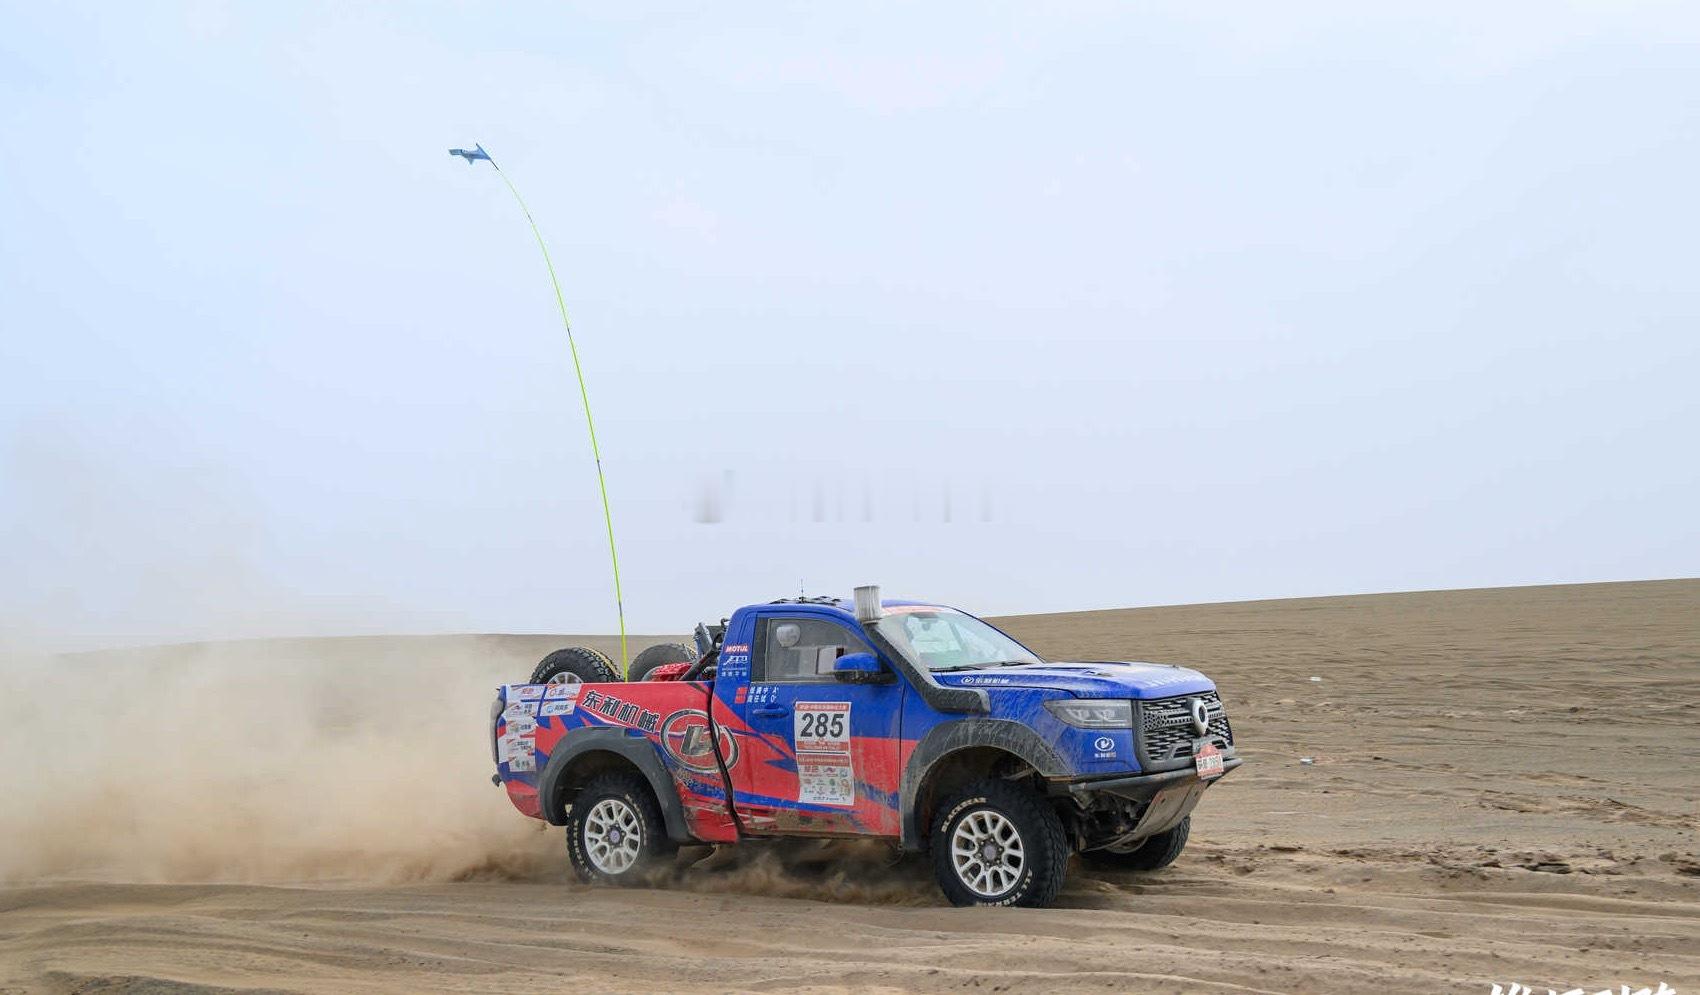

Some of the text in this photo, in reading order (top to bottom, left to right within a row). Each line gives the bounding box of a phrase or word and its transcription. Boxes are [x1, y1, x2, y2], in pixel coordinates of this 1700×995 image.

[725, 645, 749, 653] MOTUL
[582, 690, 660, 733] 东利机械
[800, 713, 845, 738] 285
